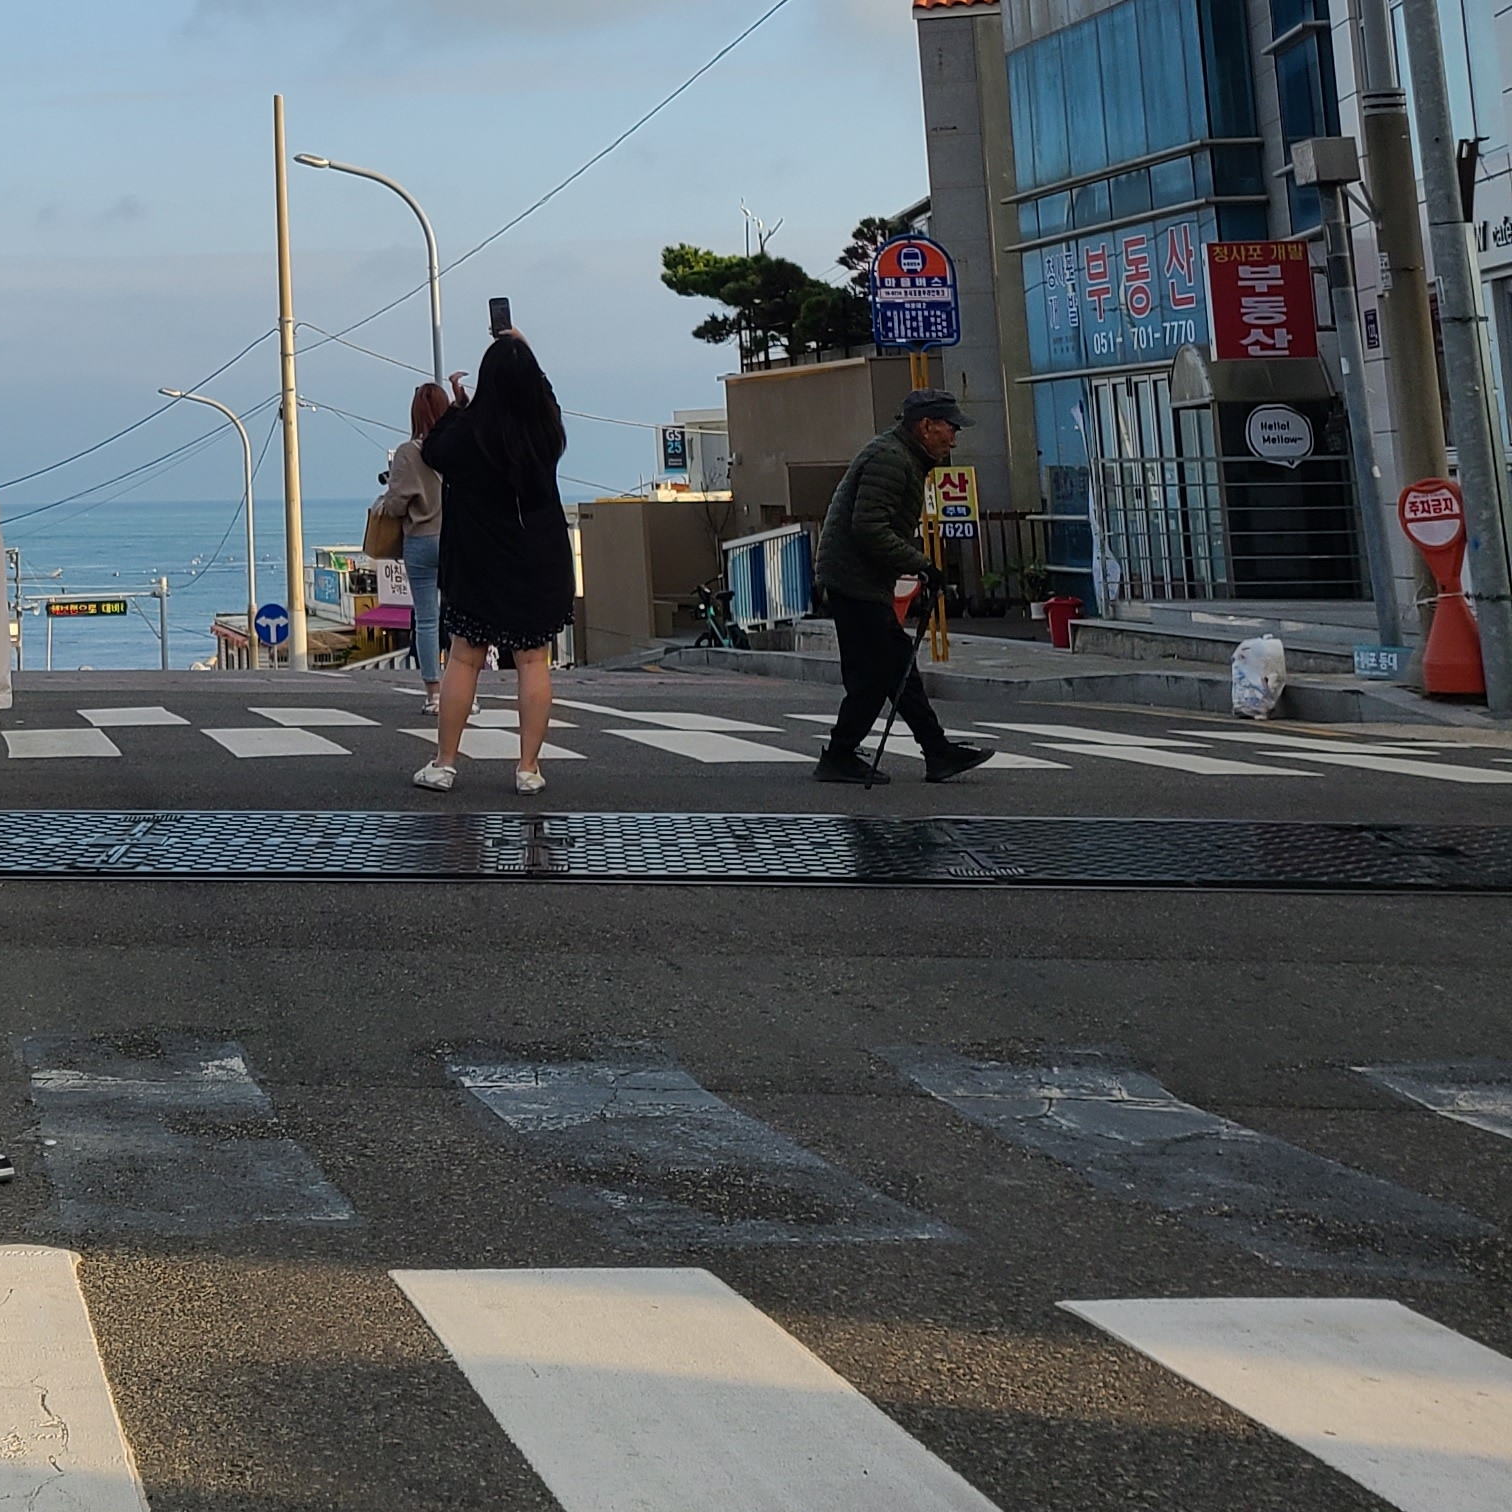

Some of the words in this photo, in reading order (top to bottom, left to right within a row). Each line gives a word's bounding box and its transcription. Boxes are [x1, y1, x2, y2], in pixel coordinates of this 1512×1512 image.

[1212, 244, 1264, 263] 청사포
[1271, 244, 1304, 261] 개발
[884, 276, 943, 288] 마을버스
[1083, 222, 1197, 324] 부동산
[1237, 264, 1293, 357] 부동산
[665, 429, 682, 441] GS
[667, 441, 683, 454] 25
[937, 472, 970, 502] 산
